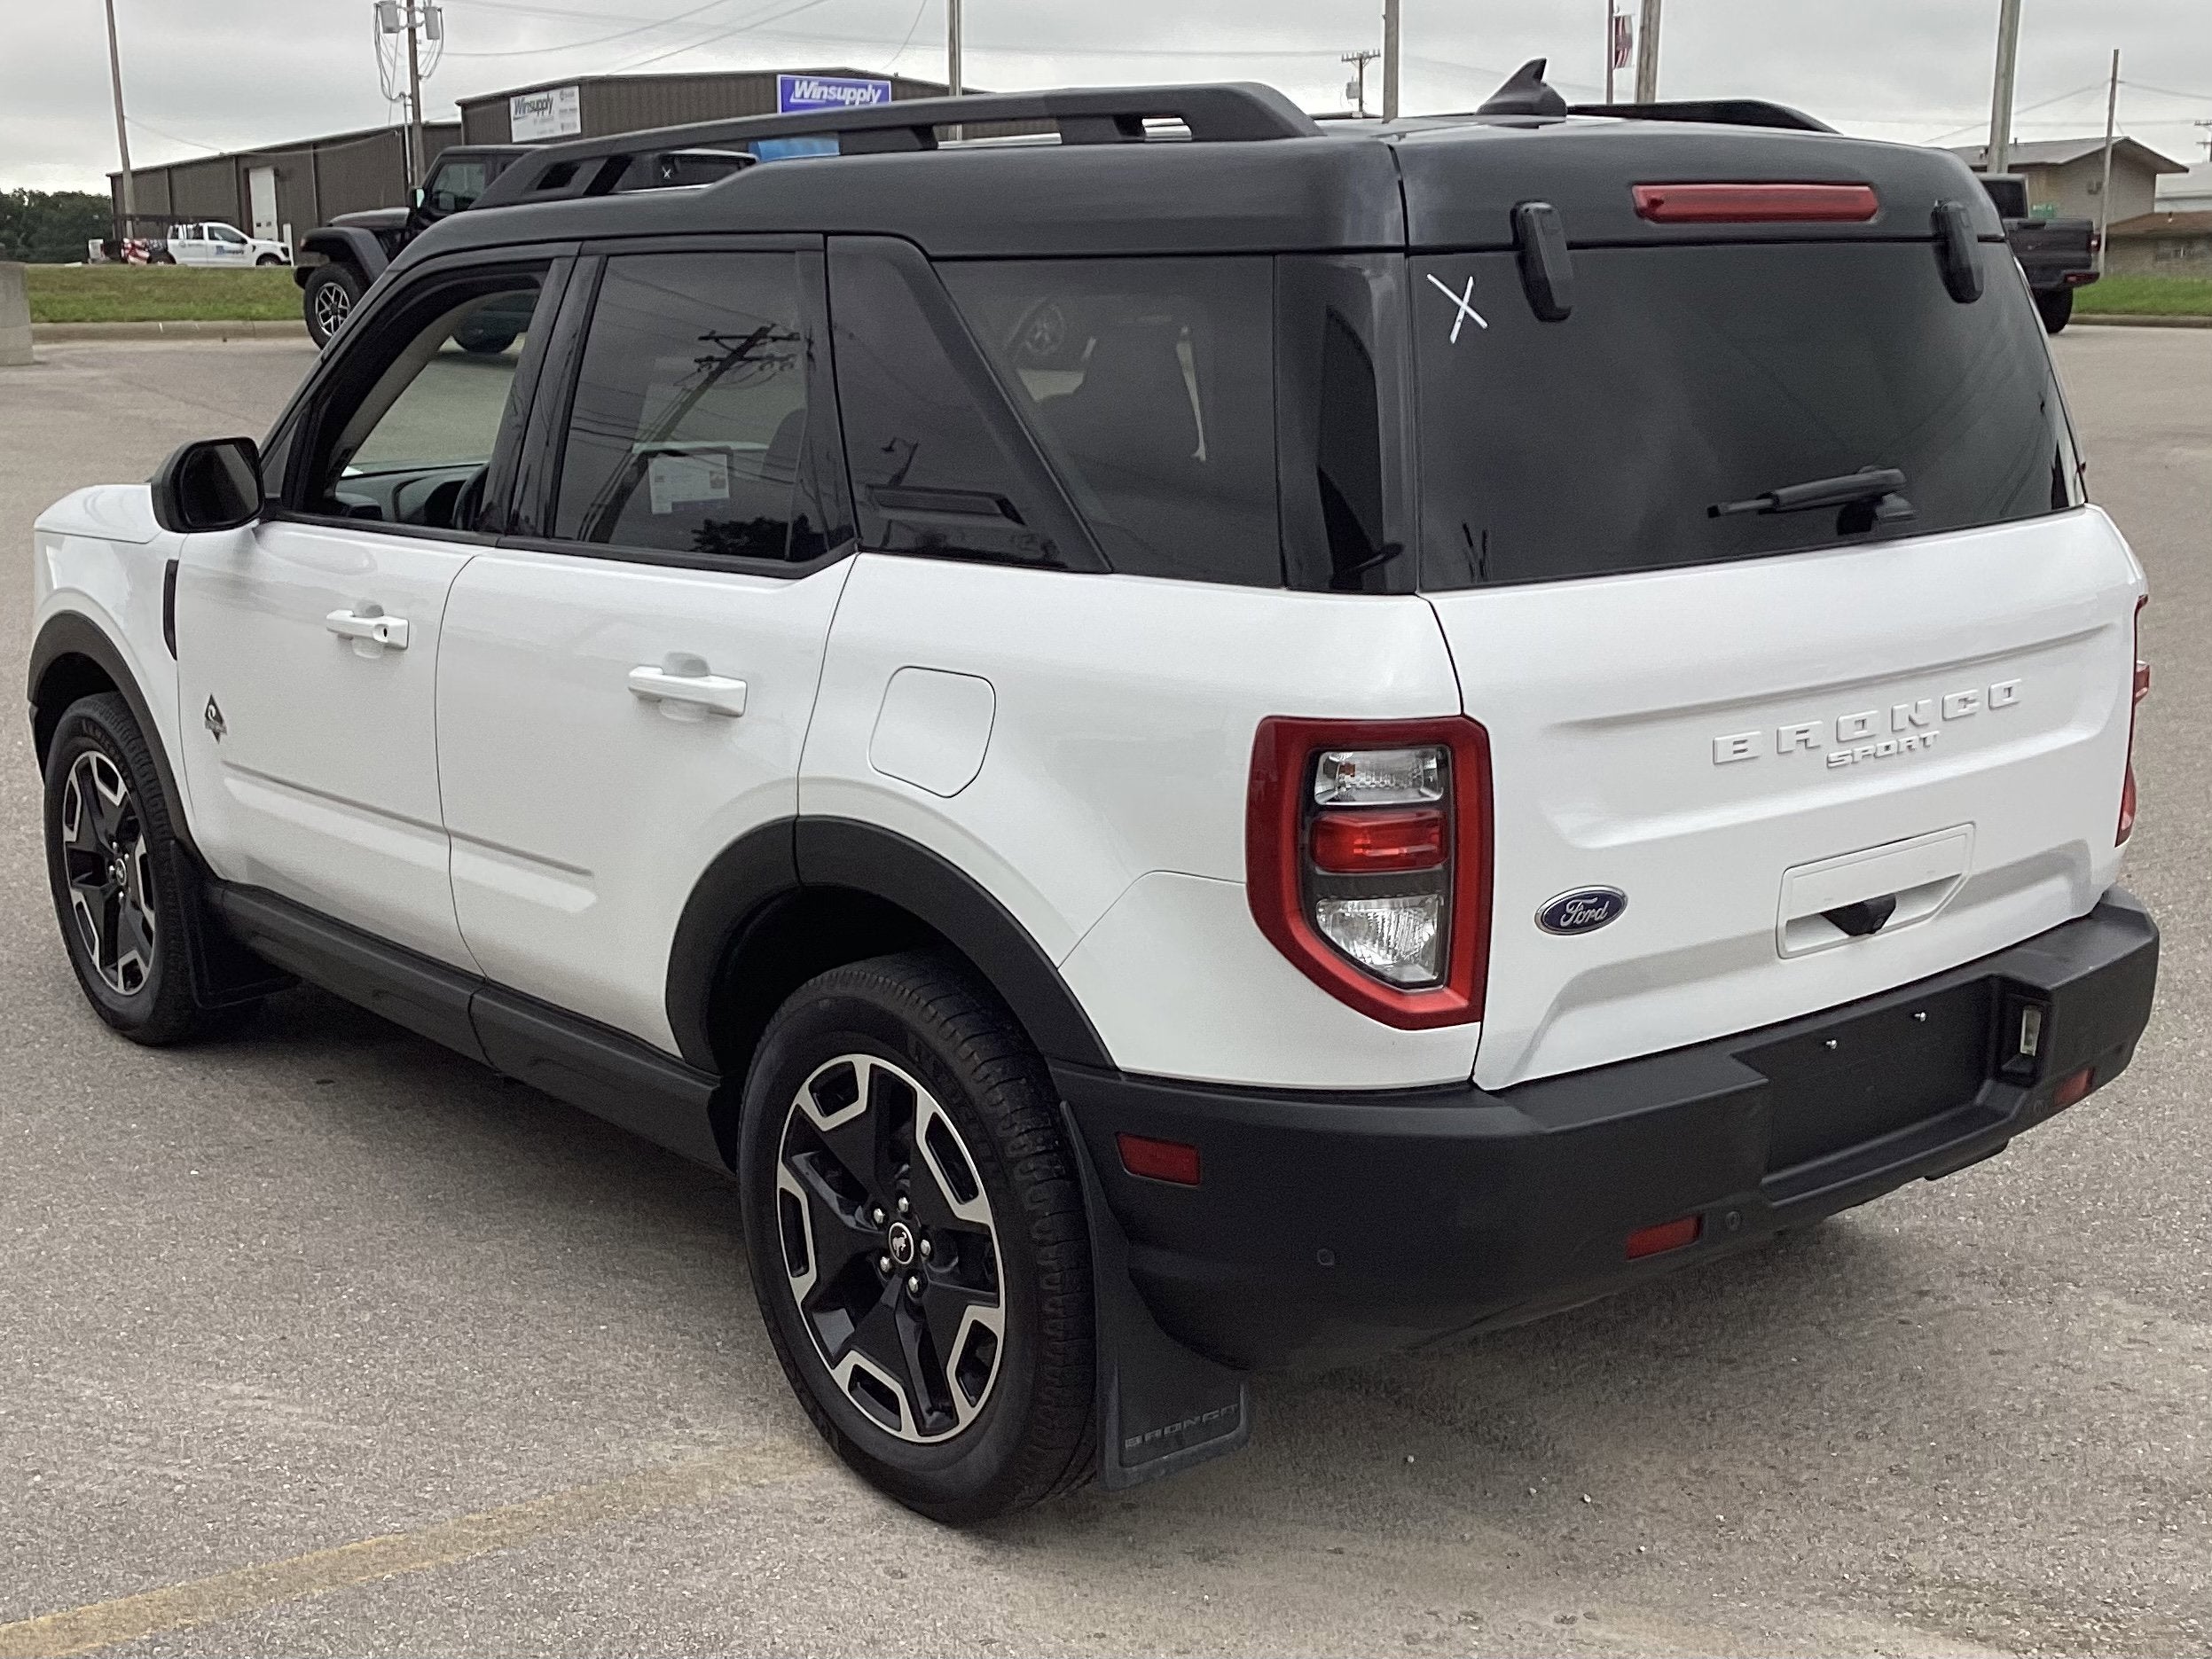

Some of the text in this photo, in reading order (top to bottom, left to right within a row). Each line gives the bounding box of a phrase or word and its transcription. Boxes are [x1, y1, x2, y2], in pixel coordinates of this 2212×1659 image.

[795, 81, 882, 106] Winsupply
[1713, 678, 2021, 764] BRONCO
[1827, 731, 1940, 768] SPORT
[1560, 896, 1610, 927] Ford
